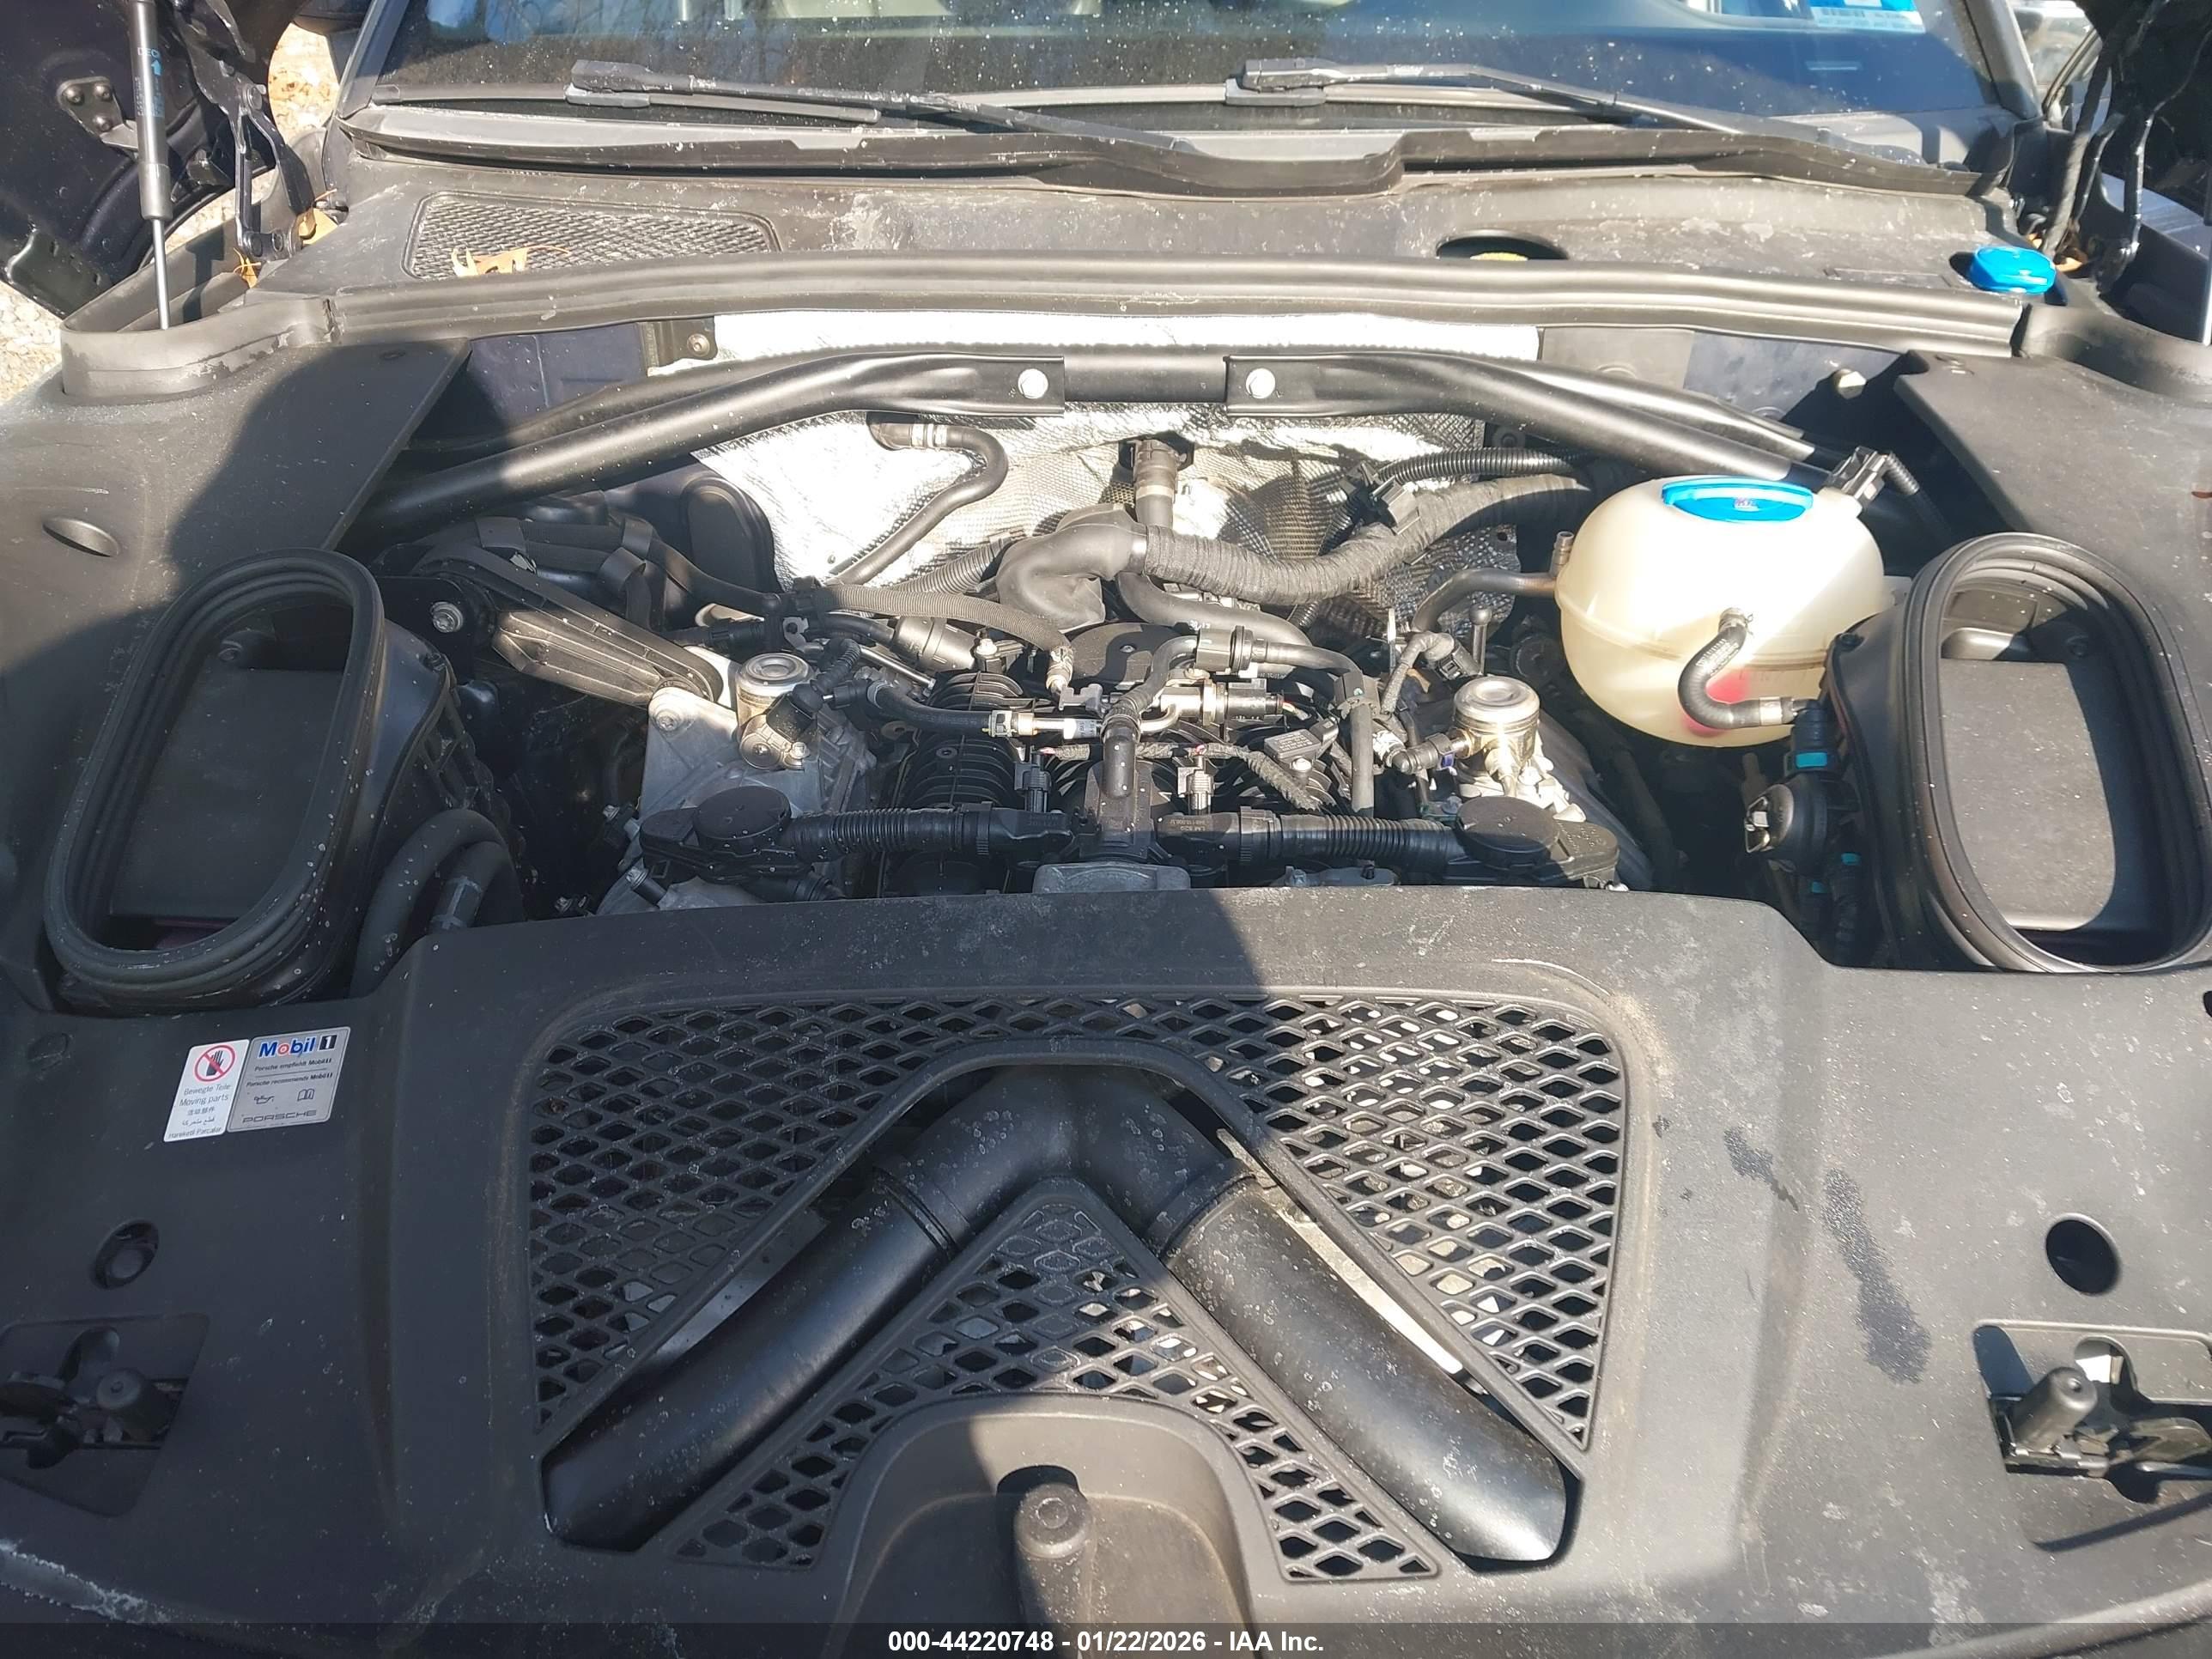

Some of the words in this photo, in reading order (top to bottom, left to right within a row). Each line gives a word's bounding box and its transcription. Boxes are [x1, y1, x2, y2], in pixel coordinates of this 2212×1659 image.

[258, 1036, 316, 1057] Mobil
[179, 1097, 207, 1106] Moving
[208, 1094, 228, 1103] parts
[242, 1109, 317, 1123] PORSCHE
